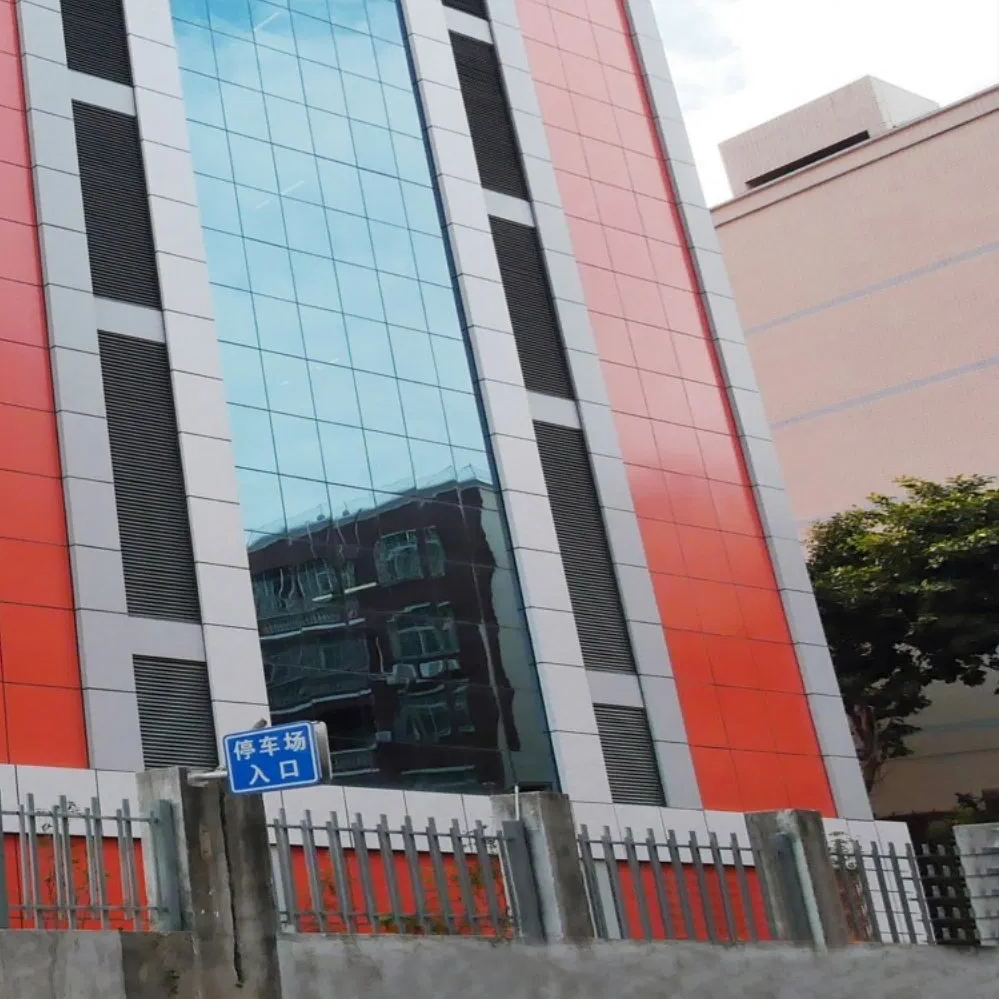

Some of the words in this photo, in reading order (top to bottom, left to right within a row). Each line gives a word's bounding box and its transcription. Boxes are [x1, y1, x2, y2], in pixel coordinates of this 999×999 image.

[233, 730, 307, 761] 停车场
[248, 759, 299, 786] 入口
